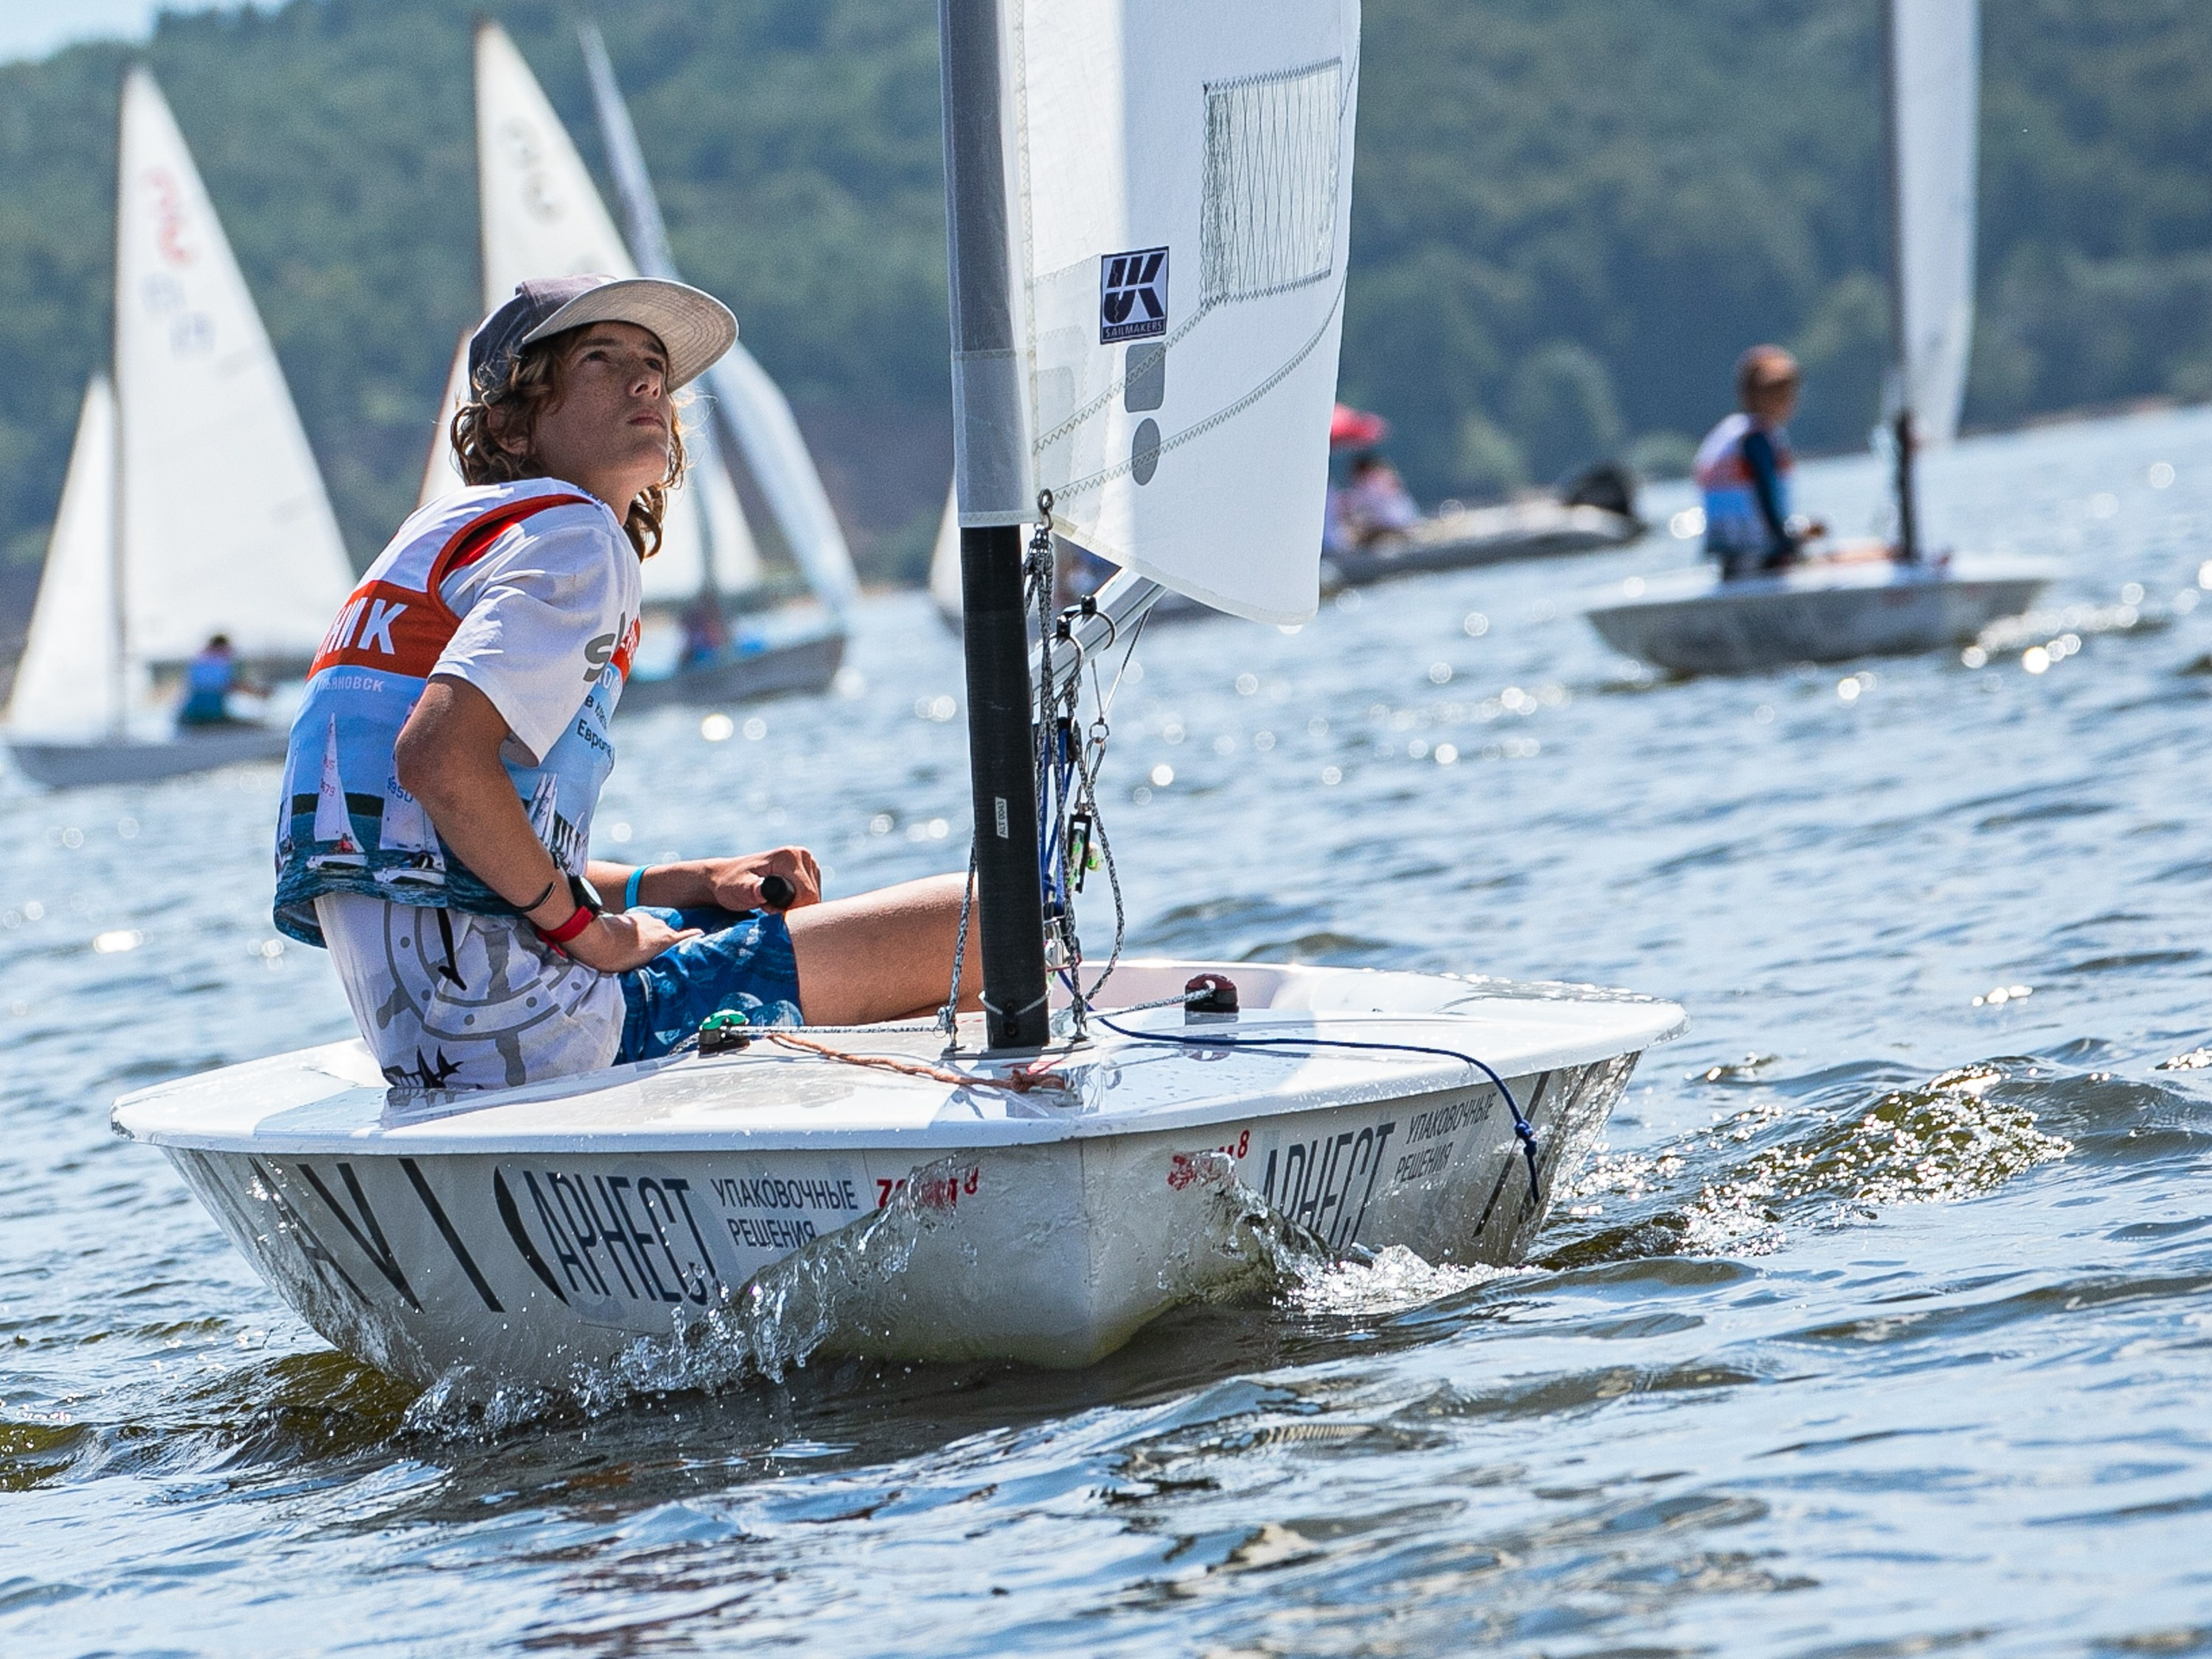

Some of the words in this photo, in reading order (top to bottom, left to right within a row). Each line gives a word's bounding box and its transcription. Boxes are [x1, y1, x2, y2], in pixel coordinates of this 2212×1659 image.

[1105, 321, 1162, 337] SAILMAKERS
[1406, 1092, 1497, 1145] УПАКОВОЧНЫЕ
[1394, 1141, 1454, 1184] РЕШЕНИЯ
[710, 1179, 858, 1211] УПАКОВОЧНЫЕ
[523, 1171, 723, 1306] АРНЕСТ
[727, 1217, 816, 1249] РЕШЕНИЯ
